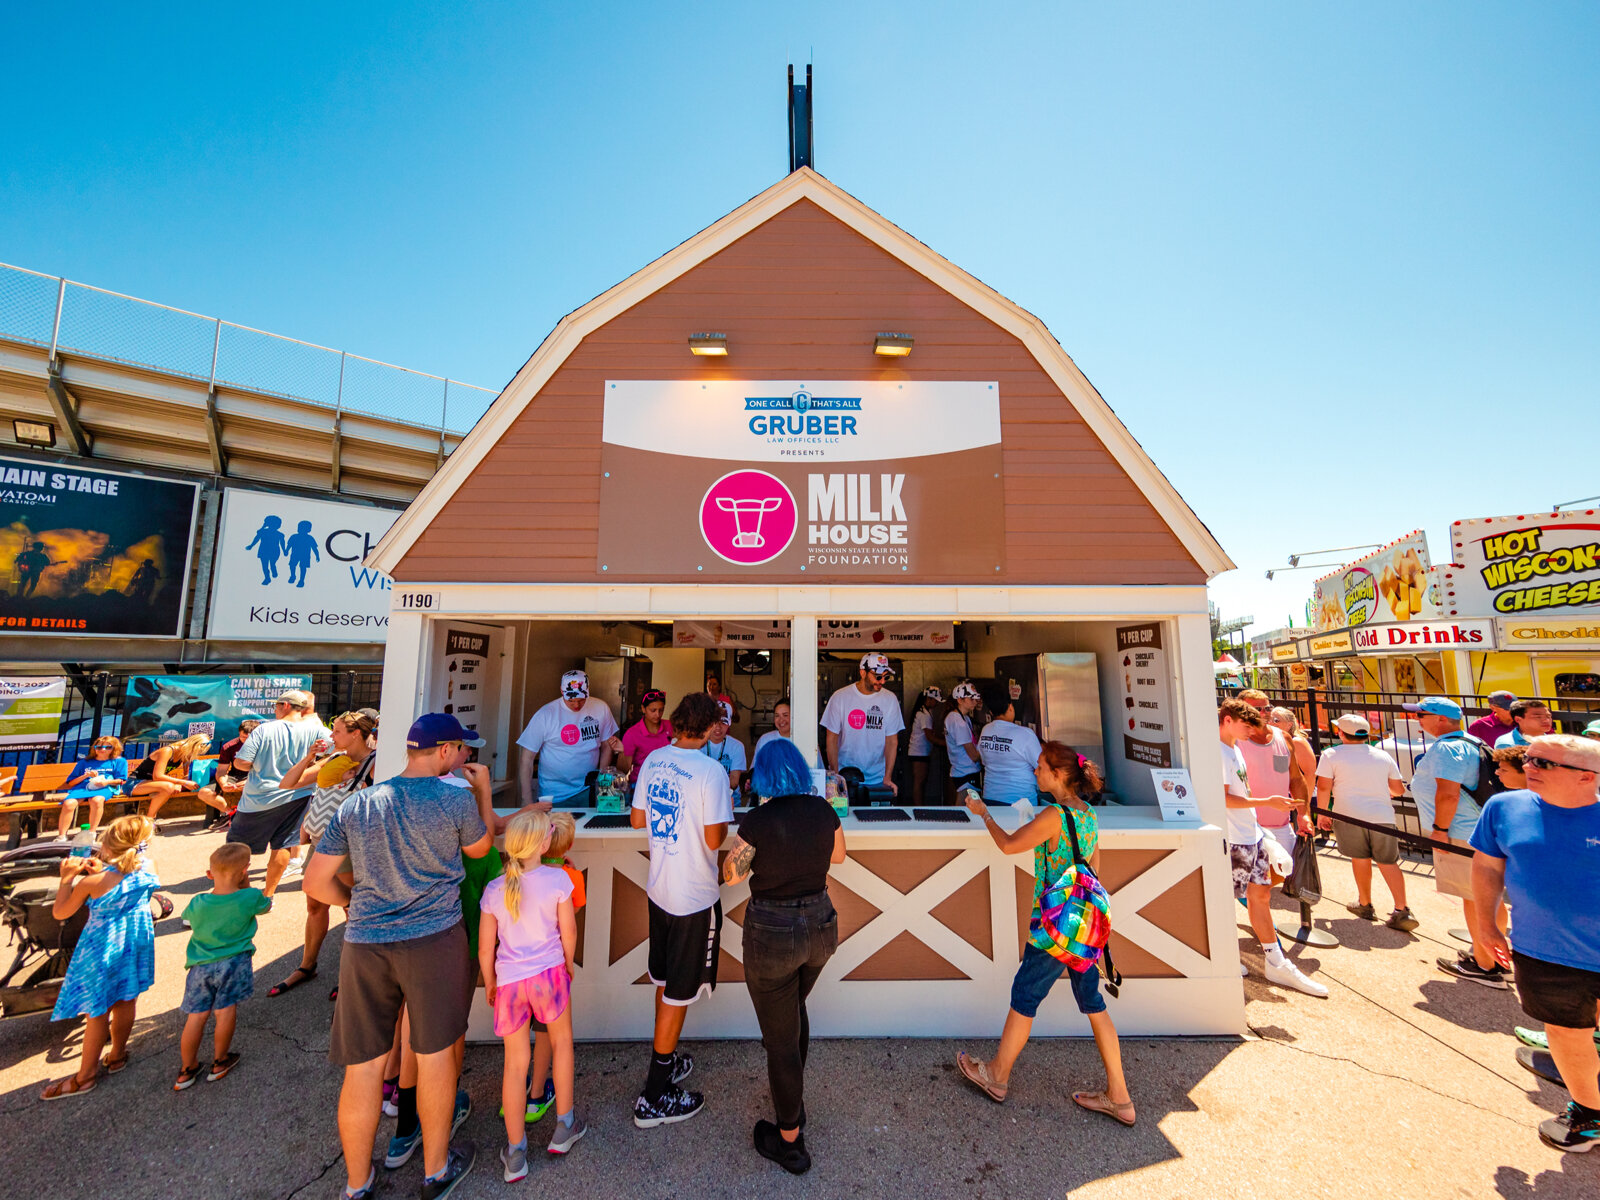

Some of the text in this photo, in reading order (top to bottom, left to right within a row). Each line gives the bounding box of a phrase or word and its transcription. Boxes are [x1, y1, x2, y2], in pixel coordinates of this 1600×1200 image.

[749, 400, 791, 408] ONE CALL
[812, 400, 858, 408] THAT'S ALL
[748, 415, 858, 435] GRUBER
[0, 466, 119, 496] AIN STAGE
[3, 498, 36, 506] CASINO
[808, 473, 908, 521] MILK
[808, 524, 908, 545] HOUSE
[1483, 527, 1542, 560] HOT
[808, 555, 908, 565] FOUNDATION
[401, 594, 433, 608] 1190
[1494, 580, 1600, 612] CHEESE
[250, 606, 299, 624] Kids
[0, 616, 87, 629] FOR DETAILS
[1120, 629, 1154, 644] $1 PER CUP
[1355, 625, 1483, 647] Cold Drinks
[1512, 626, 1600, 639] Chedd
[458, 636, 470, 649] PER
[471, 637, 483, 650] CUP
[1135, 652, 1154, 660] CHOCOLATE
[231, 677, 303, 688] CAN YOU SPARE
[234, 688, 263, 699] SOME
[228, 699, 237, 707] TO
[238, 699, 268, 707] SUPPORT
[1138, 701, 1159, 709] CHOCOLATE
[866, 715, 884, 725] MILK
[1140, 721, 1164, 731] STRAWBERRY
[580, 724, 600, 737] MILK
[980, 742, 1010, 752] GRUBER
